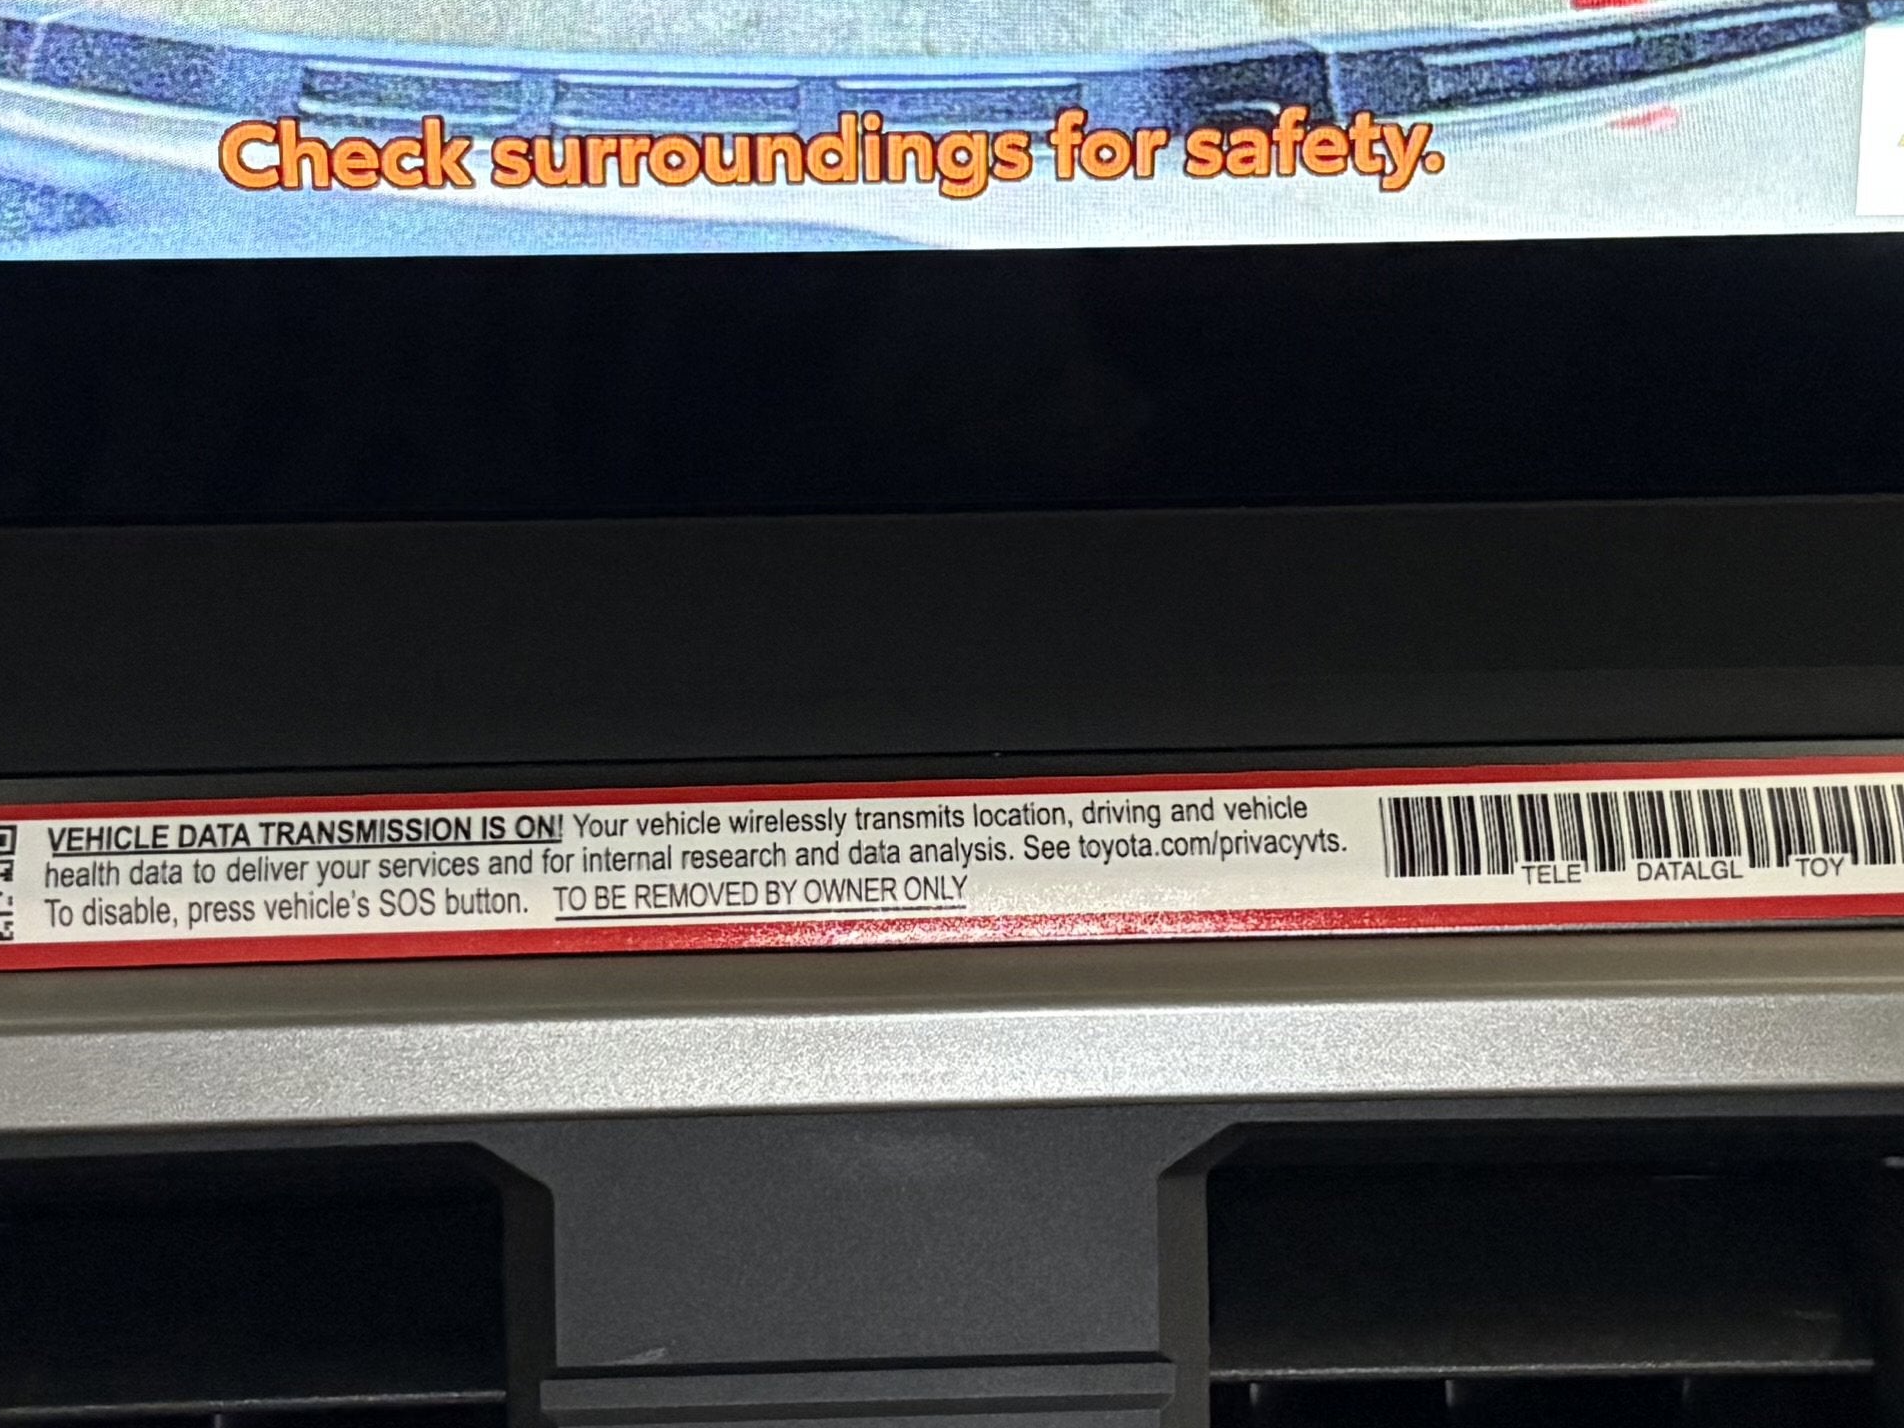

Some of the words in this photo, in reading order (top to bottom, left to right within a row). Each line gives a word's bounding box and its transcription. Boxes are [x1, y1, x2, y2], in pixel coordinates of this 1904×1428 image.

[220, 114, 474, 192] Check
[489, 109, 1034, 199] surroundings
[1051, 108, 1169, 180] for
[1182, 104, 1446, 192] safety.
[47, 824, 170, 852] VEHICLE
[178, 822, 251, 849] DATA
[258, 816, 472, 847] TRANSMISSION
[482, 815, 506, 840] IS
[515, 813, 564, 839] ON!
[573, 812, 629, 838] Your
[636, 811, 721, 836] vehicle
[728, 806, 847, 837] wirelessly
[855, 803, 965, 831] transmits
[973, 801, 1074, 829] location,
[1082, 799, 1161, 829] driving
[1171, 796, 1215, 822] and
[1223, 795, 1308, 821] vehicle
[45, 858, 120, 888] health
[129, 859, 183, 886] data
[193, 859, 216, 884] to
[227, 856, 309, 883] deliver
[317, 859, 371, 888] your
[378, 851, 480, 879] services
[488, 848, 533, 875] and
[542, 847, 575, 874] for
[582, 844, 673, 872] internal
[681, 842, 786, 870] research
[795, 840, 840, 867] and
[848, 838, 900, 865] data
[909, 836, 1015, 869] analysis.
[1024, 834, 1071, 860] See
[1078, 828, 1348, 865] toyota.com/privacyvts.
[1520, 862, 1583, 886] TELE
[1636, 856, 1744, 882] DATALGL
[1796, 855, 1846, 879] TOY
[45, 898, 74, 927] To
[82, 896, 179, 927] disable,
[188, 898, 256, 930] press
[379, 887, 436, 917] SOS
[445, 887, 529, 915] button.
[553, 886, 587, 912] TO
[595, 884, 627, 911] BE
[635, 881, 759, 909] REMOVED
[765, 879, 798, 906] BY
[804, 877, 896, 904] OWNER
[904, 874, 968, 902] ONLY
